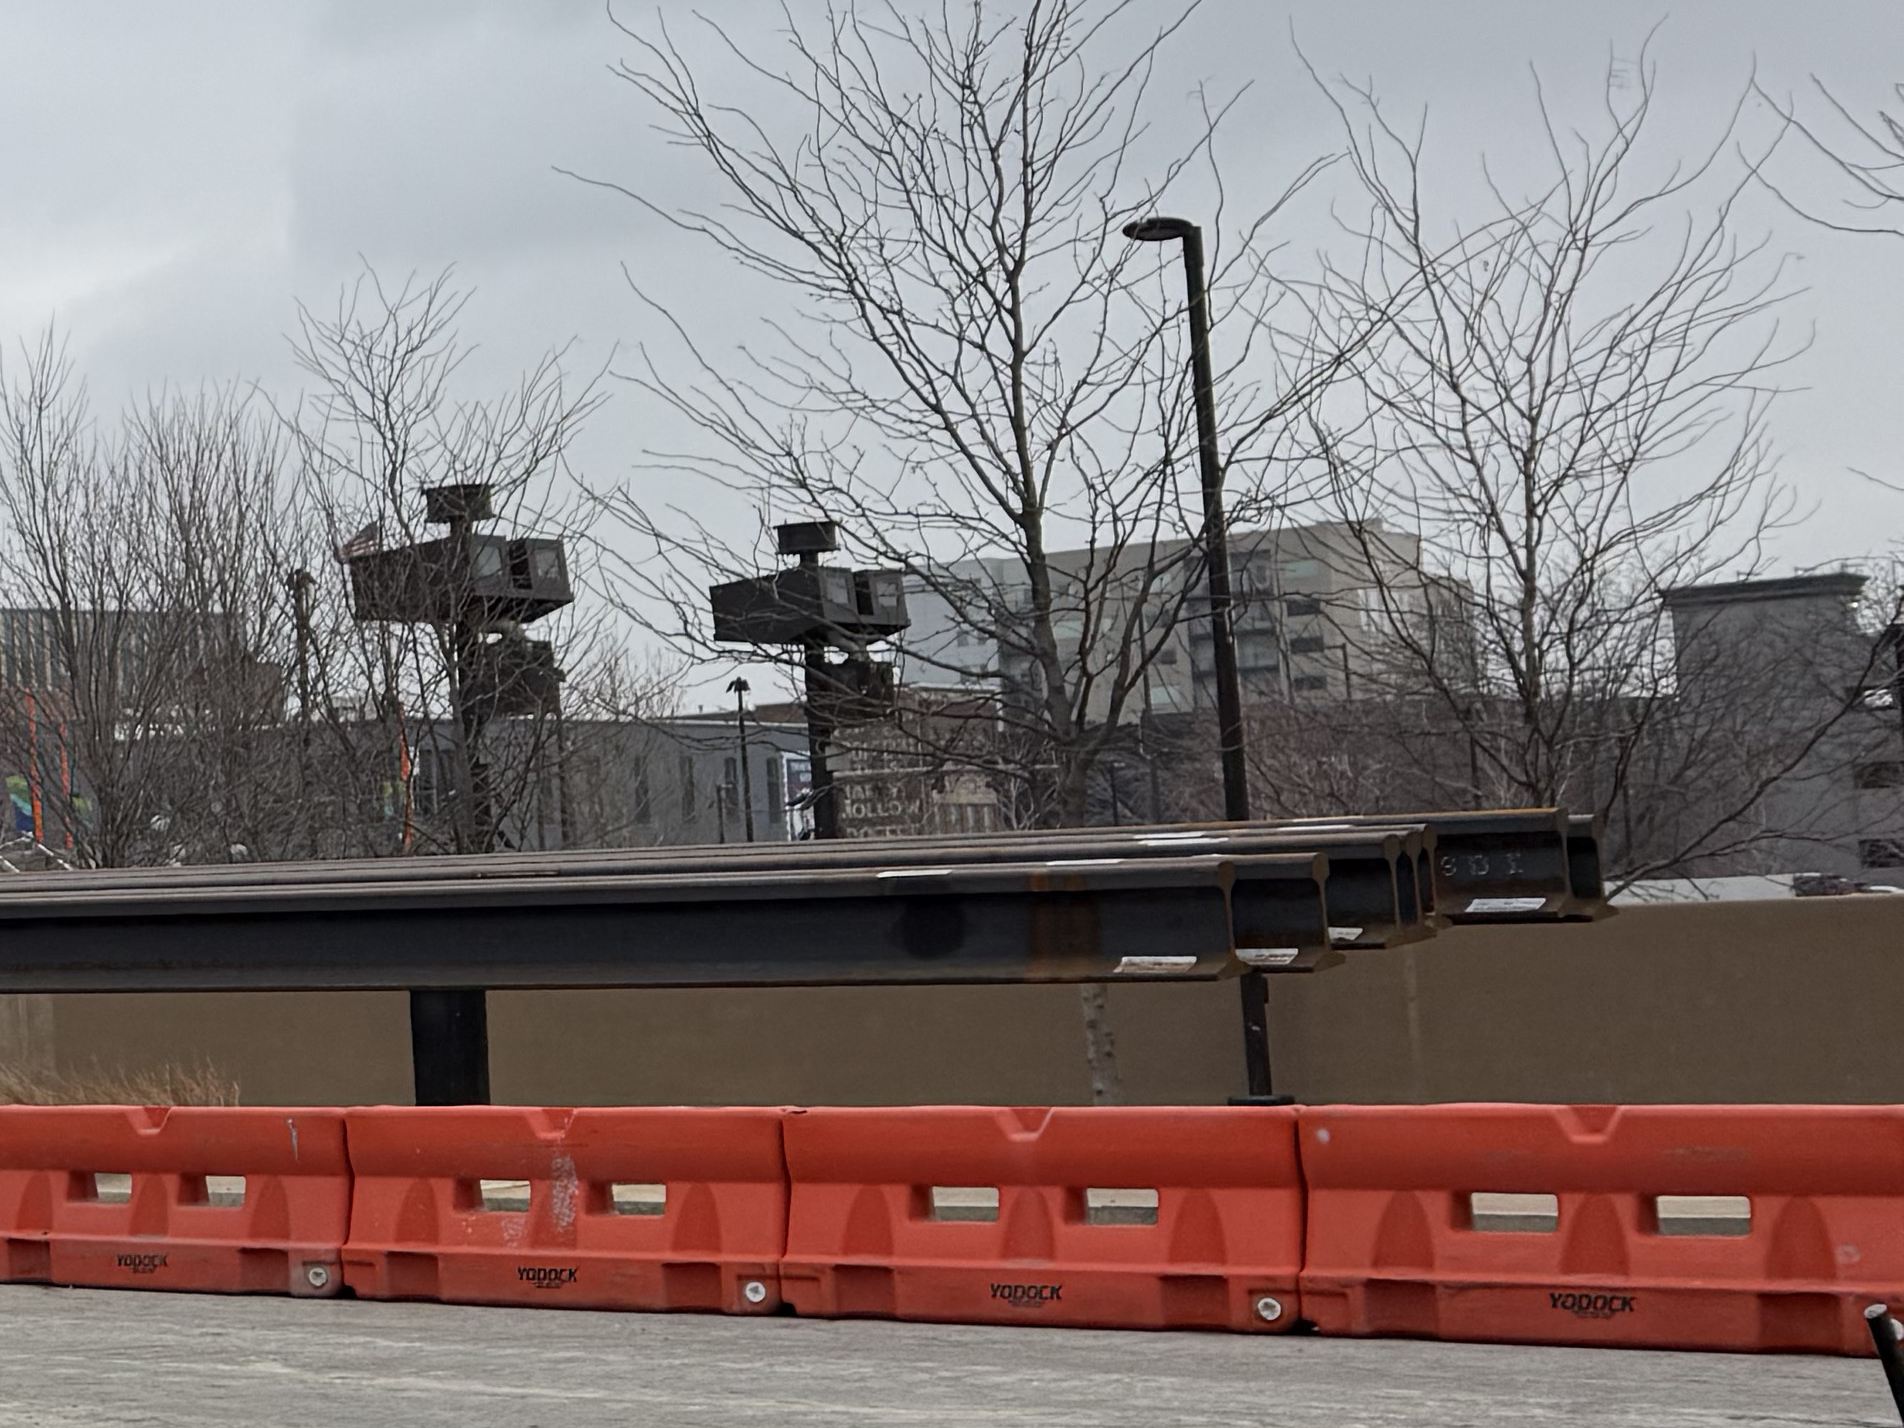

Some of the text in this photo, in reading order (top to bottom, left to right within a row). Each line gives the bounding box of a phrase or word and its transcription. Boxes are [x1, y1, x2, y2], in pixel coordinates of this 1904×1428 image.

[116, 1253, 168, 1268] YODOCK
[517, 1266, 580, 1282] YODOCK
[990, 1283, 1062, 1301] YODOCK
[1549, 1292, 1637, 1312] YODOCK
